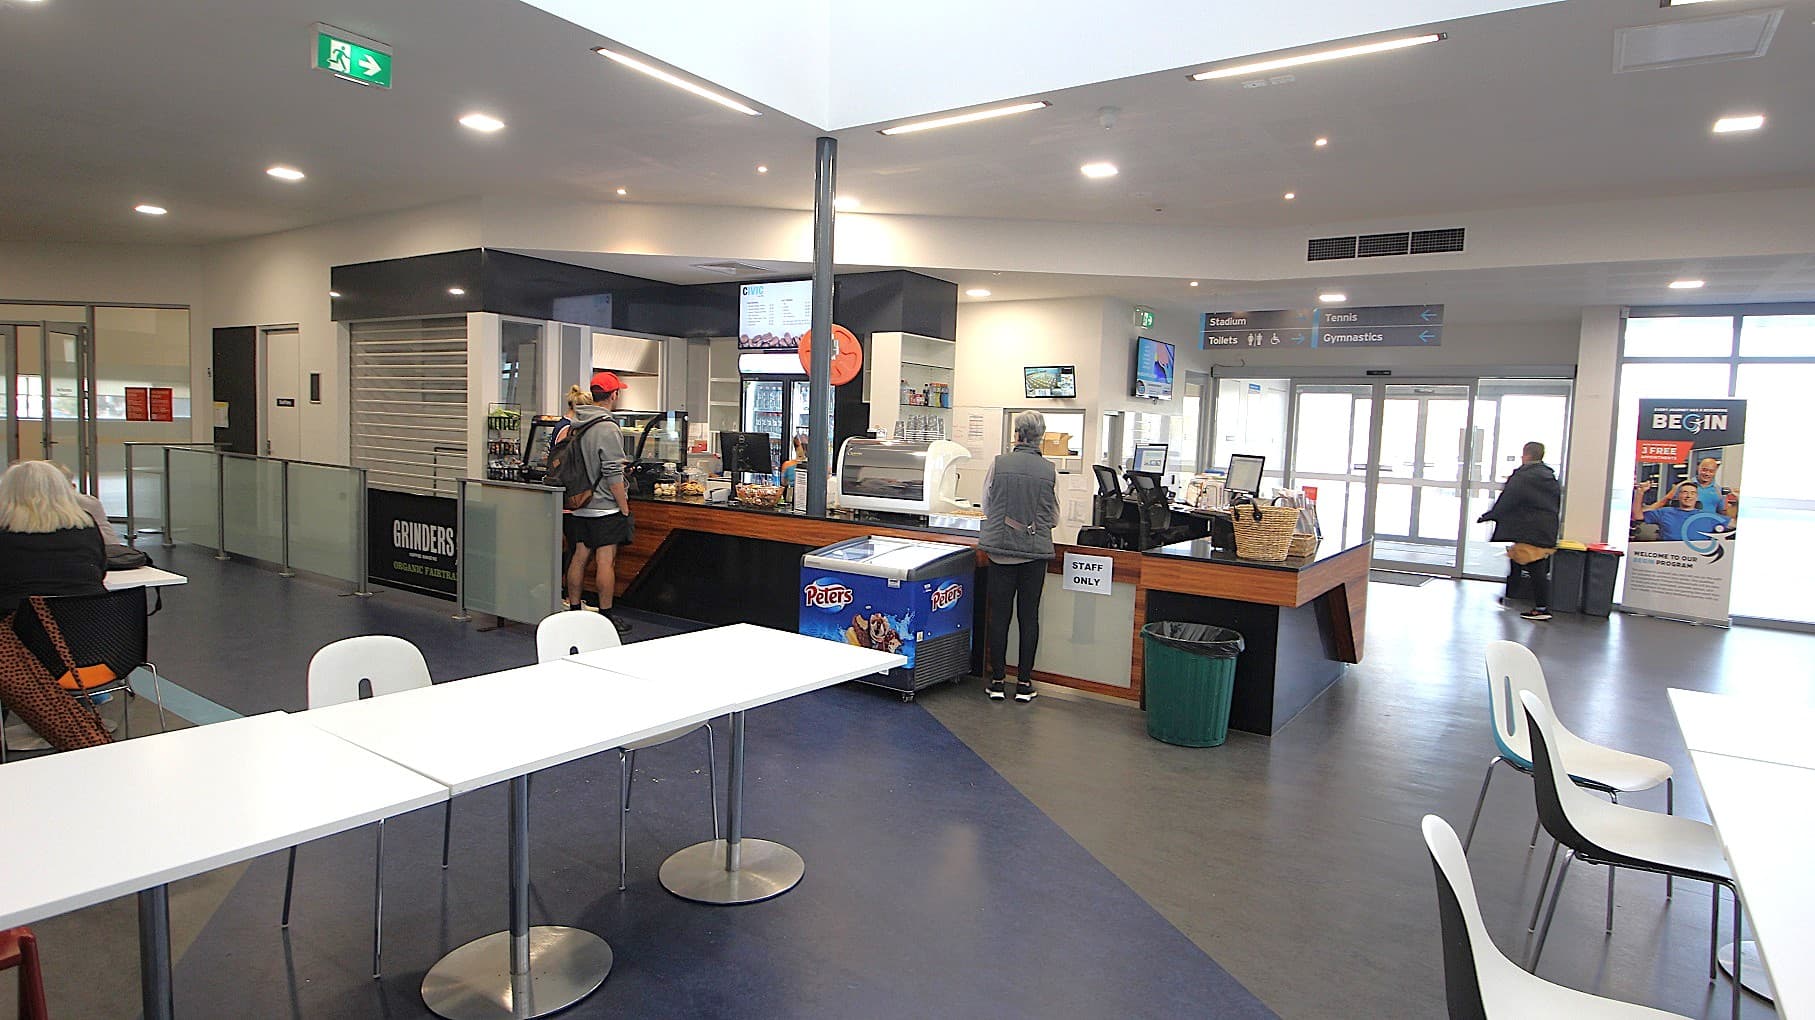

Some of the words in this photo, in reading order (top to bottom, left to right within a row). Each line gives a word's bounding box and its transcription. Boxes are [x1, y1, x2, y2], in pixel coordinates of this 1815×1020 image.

[743, 286, 764, 296] CIVIC
[1209, 317, 1247, 326] Stadium
[1325, 313, 1358, 322] Tennis
[1208, 335, 1238, 345] Toilets
[1323, 332, 1383, 344] Gymnastics
[1652, 413, 1728, 434] BEGIN
[1649, 447, 1677, 455] FREE
[393, 519, 454, 556] GRINDERS
[1633, 551, 1668, 559] WELCOME
[393, 561, 423, 575] ORGANIC
[1072, 561, 1104, 572] STAFF
[1656, 560, 1693, 568] PROGRAM
[1073, 576, 1101, 587] ONLY
[803, 584, 853, 606] Peters
[931, 584, 962, 612] Peters
